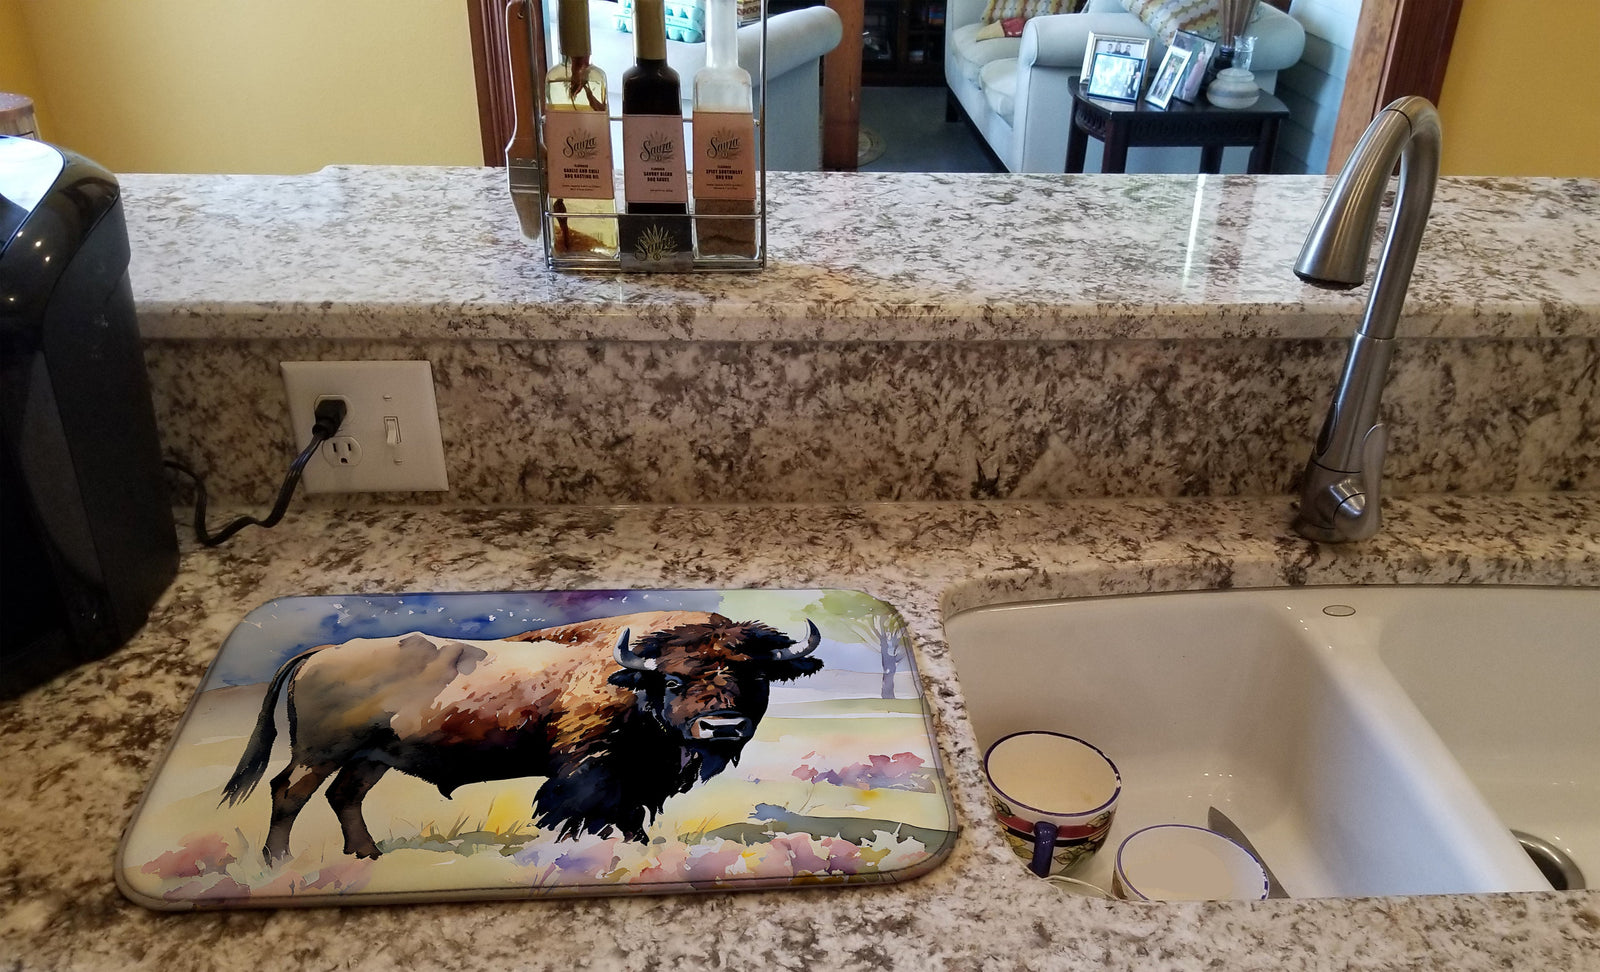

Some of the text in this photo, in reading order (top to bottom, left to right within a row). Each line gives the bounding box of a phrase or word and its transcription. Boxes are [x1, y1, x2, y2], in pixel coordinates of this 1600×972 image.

[562, 136, 597, 158] Sauza
[640, 140, 673, 161] Sauza
[706, 137, 739, 158] Sauza
